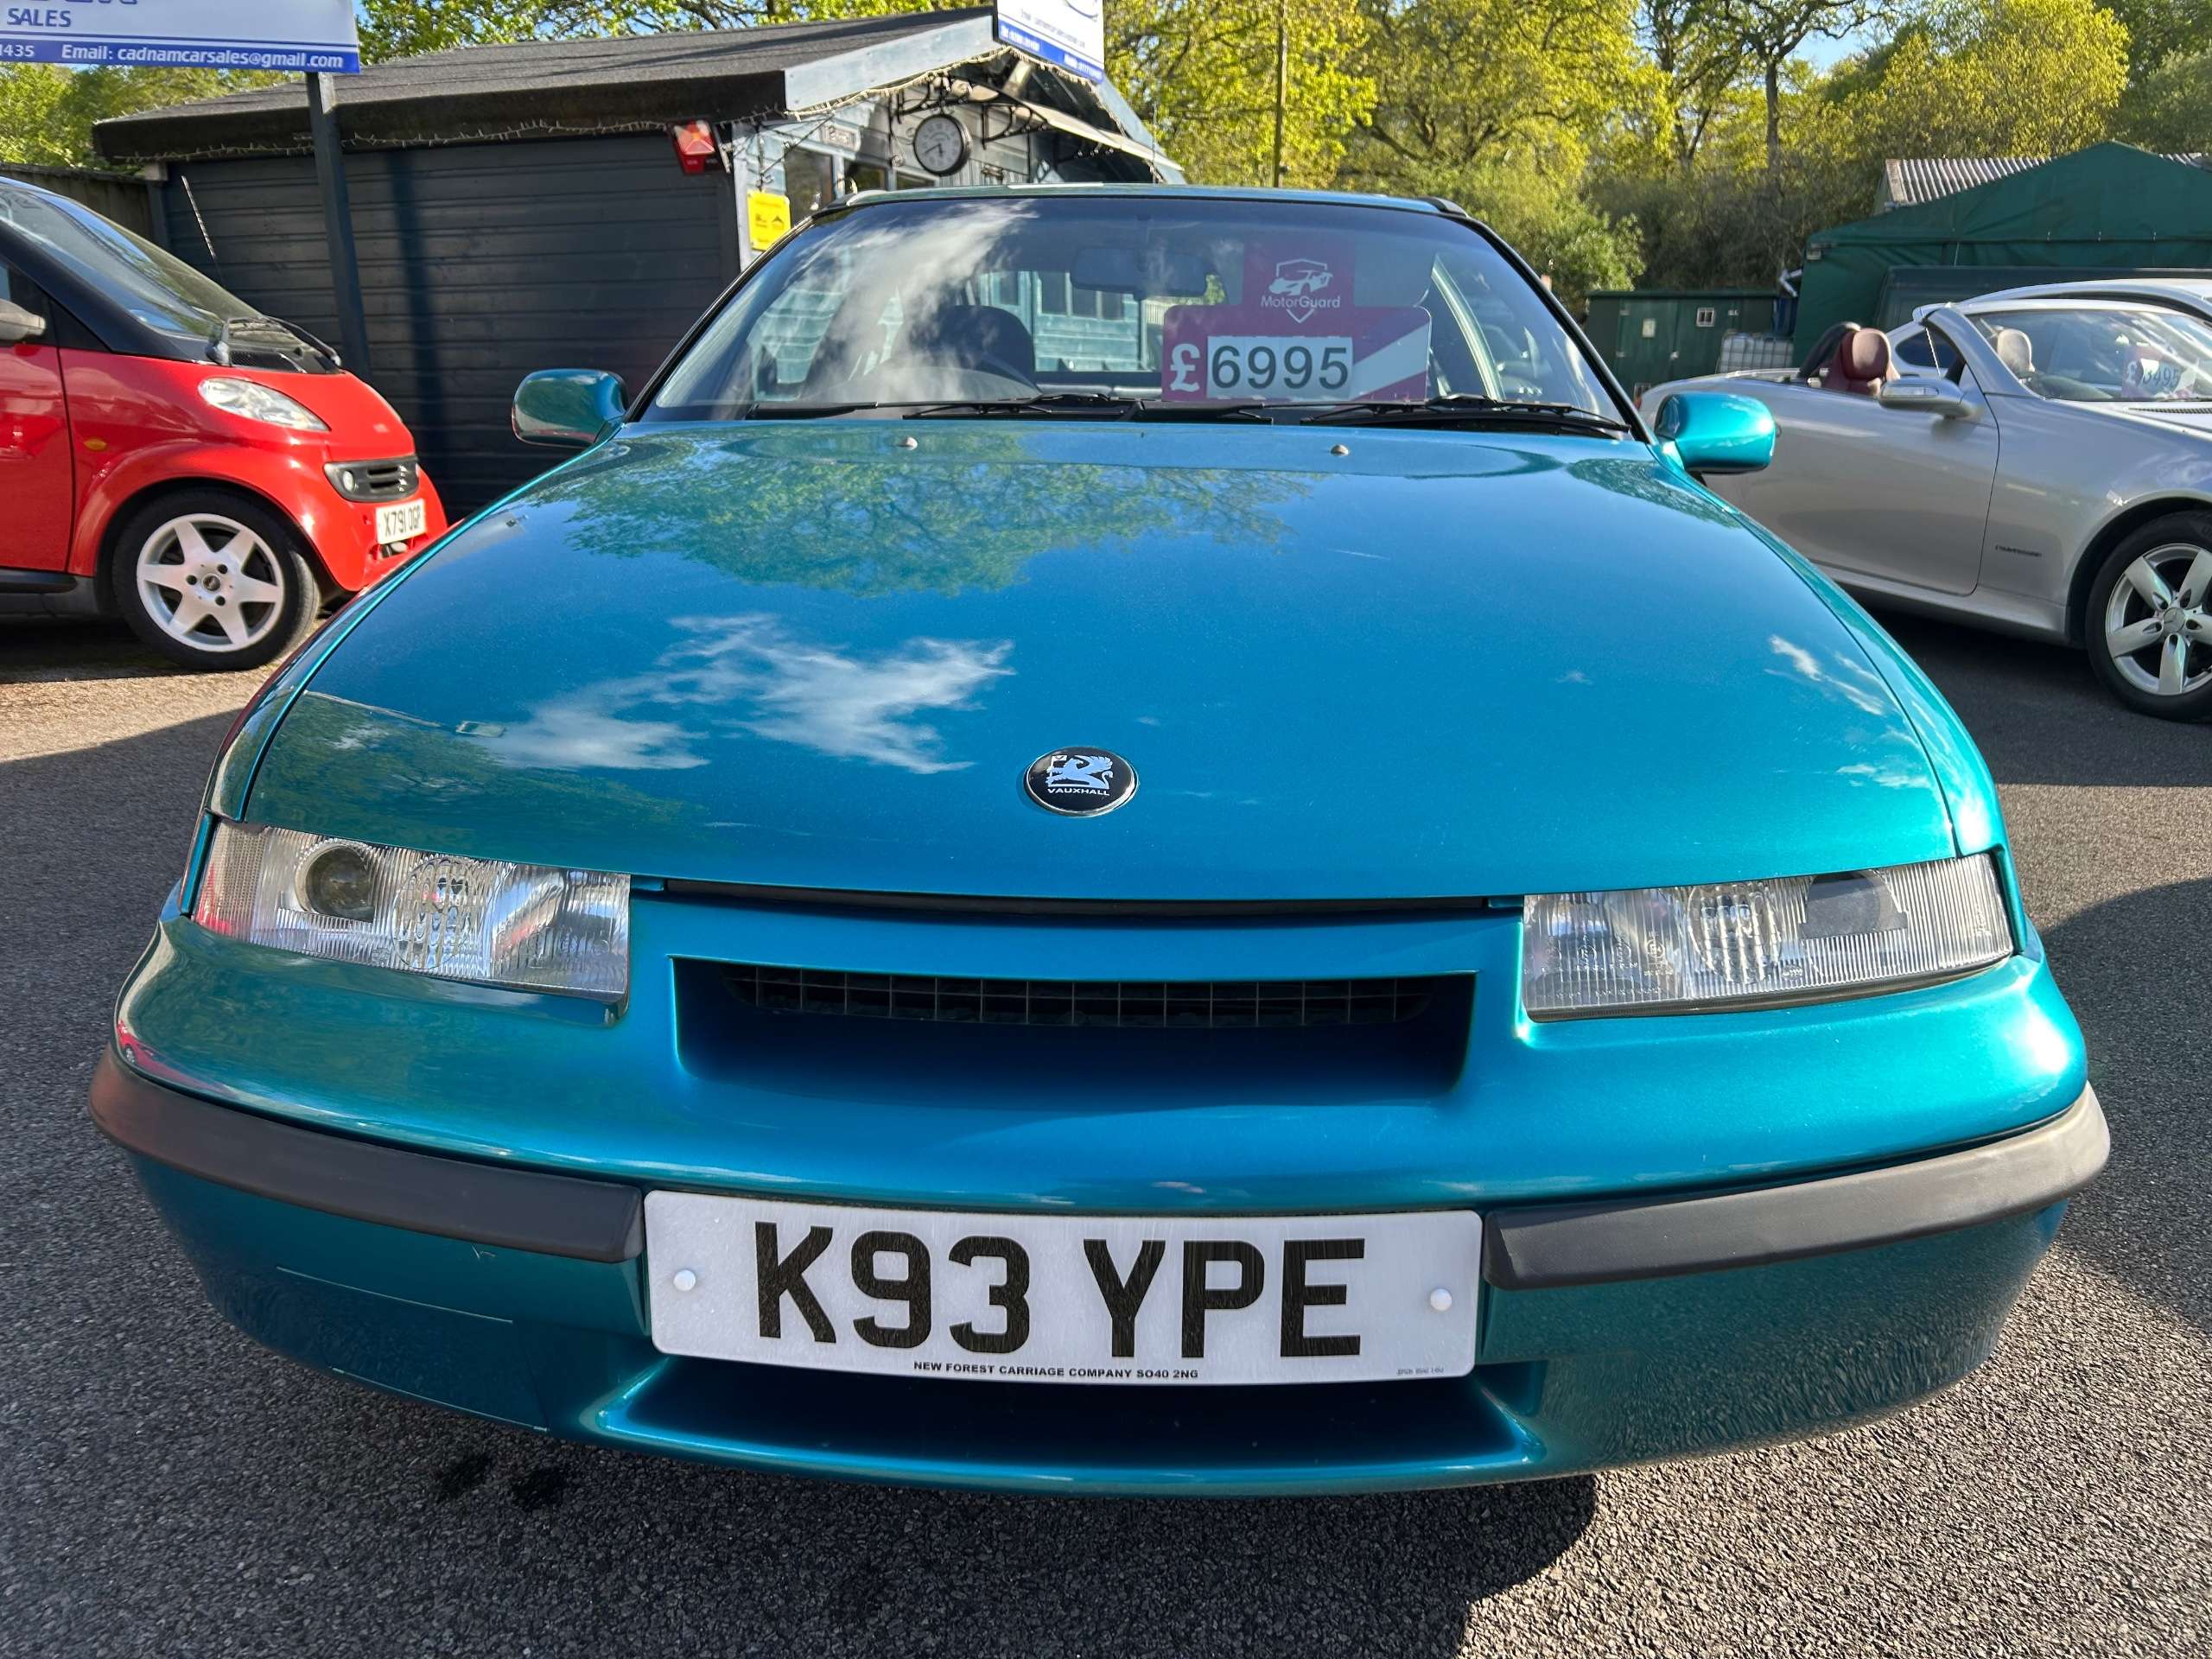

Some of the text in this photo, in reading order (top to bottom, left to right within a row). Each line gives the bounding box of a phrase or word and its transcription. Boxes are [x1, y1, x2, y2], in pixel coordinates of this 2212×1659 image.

[7, 8, 72, 28] SALES
[61, 44, 113, 60] Email:
[118, 47, 344, 68] cadnamcarsales@gmail.com
[1261, 295, 1341, 308] MotorGuard
[1047, 787, 1110, 796] VAUXHALL
[755, 1221, 1365, 1358] K93 YPE
[913, 1361, 1198, 1378] NEW FOREST CARRIAGE COMPANY SO40 2NG
